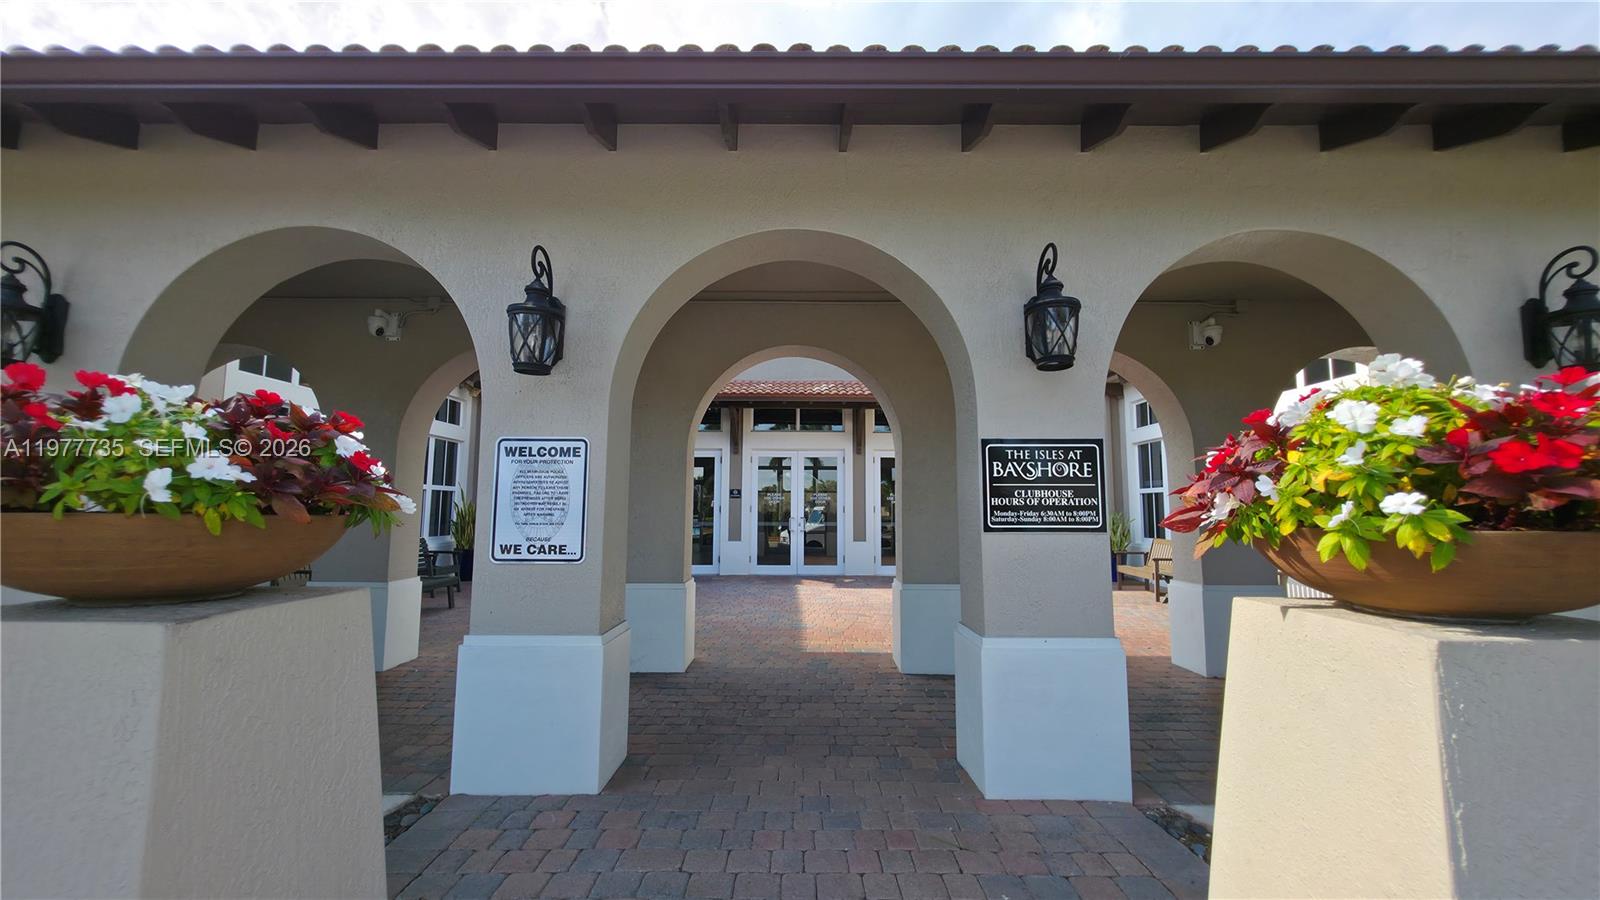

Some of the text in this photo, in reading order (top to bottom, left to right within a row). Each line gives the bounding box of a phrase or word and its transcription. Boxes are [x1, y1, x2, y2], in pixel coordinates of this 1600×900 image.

[504, 446, 582, 458] WELCOME
[1005, 450, 1083, 460] THE ISLES AT
[992, 461, 1093, 480] BAYSHORE
[1014, 489, 1075, 498] CLUBHOUSE
[991, 498, 1098, 506] HOURS OF OPERATION
[993, 510, 1039, 518] Monday-Friday
[499, 544, 577, 555] WE CARE...
